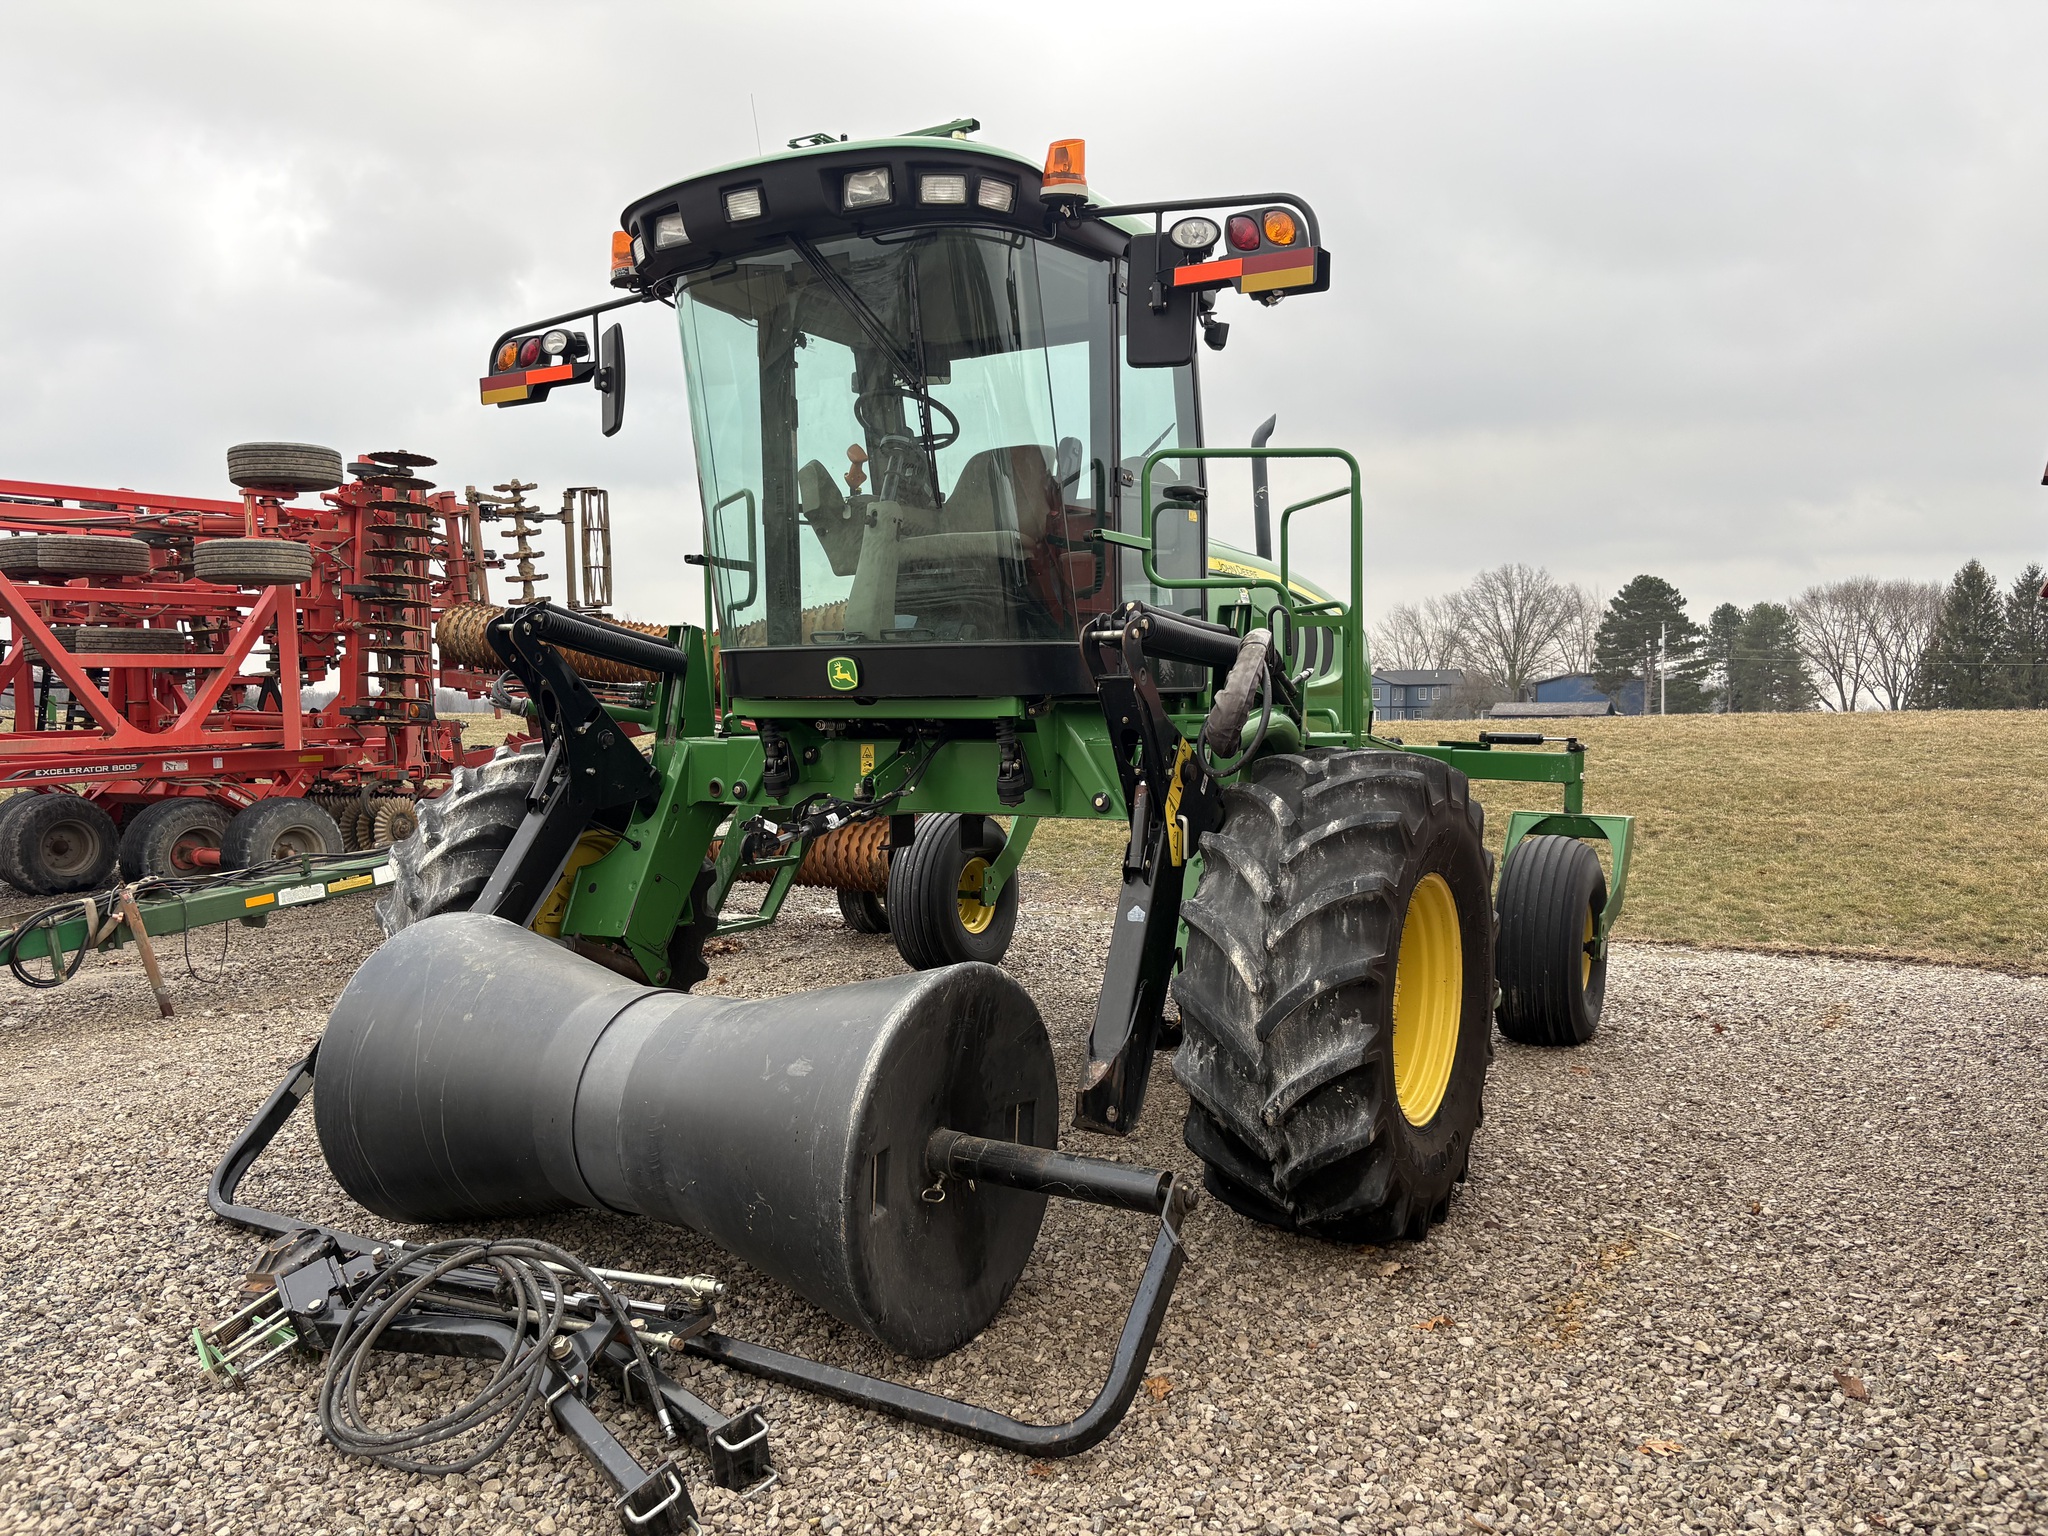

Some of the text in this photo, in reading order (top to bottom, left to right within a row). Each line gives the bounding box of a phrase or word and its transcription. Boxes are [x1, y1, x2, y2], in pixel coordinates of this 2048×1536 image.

[1217, 561, 1236, 575] JOHN
[35, 763, 138, 776] EXCELERATOR 8005
